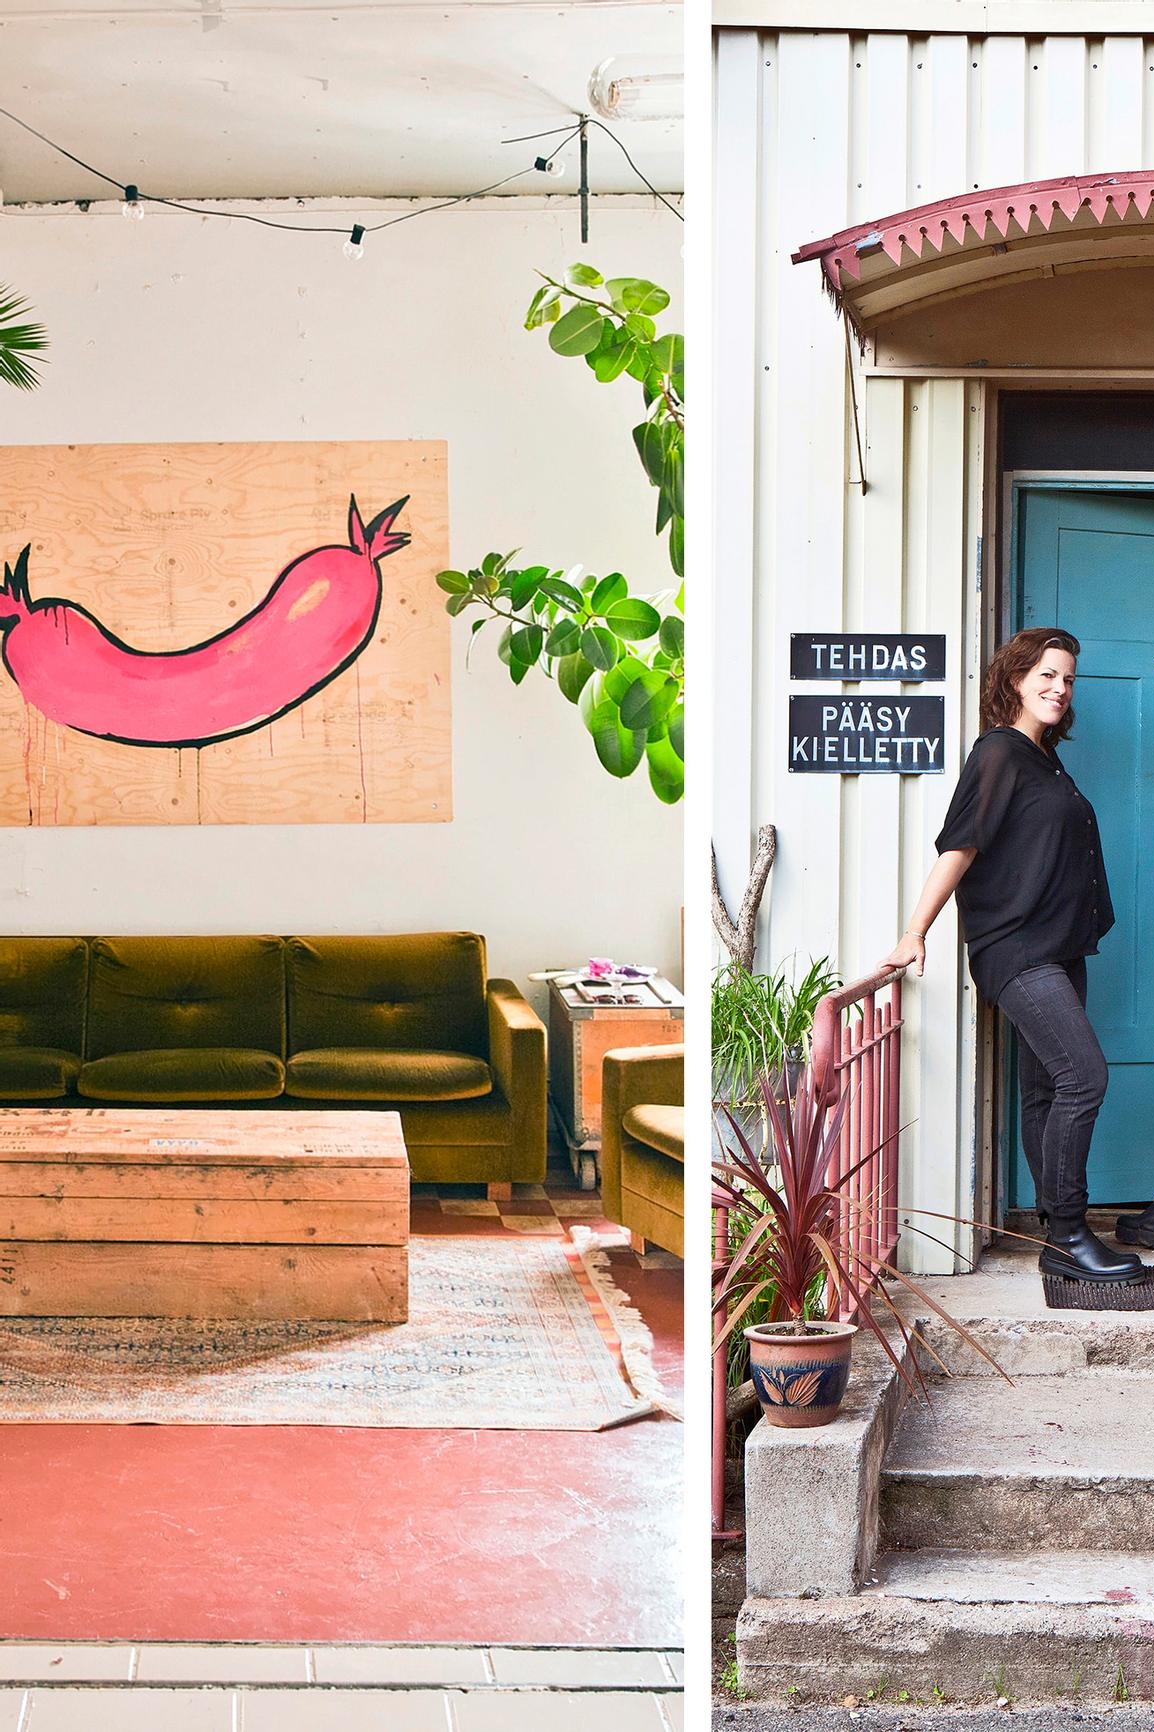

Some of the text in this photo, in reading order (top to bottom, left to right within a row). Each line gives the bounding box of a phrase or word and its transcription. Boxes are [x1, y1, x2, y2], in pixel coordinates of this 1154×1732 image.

[811, 644, 927, 670] TEHDAS
[822, 702, 911, 732] PÄÄSY
[792, 736, 940, 763] KIELLETTY
